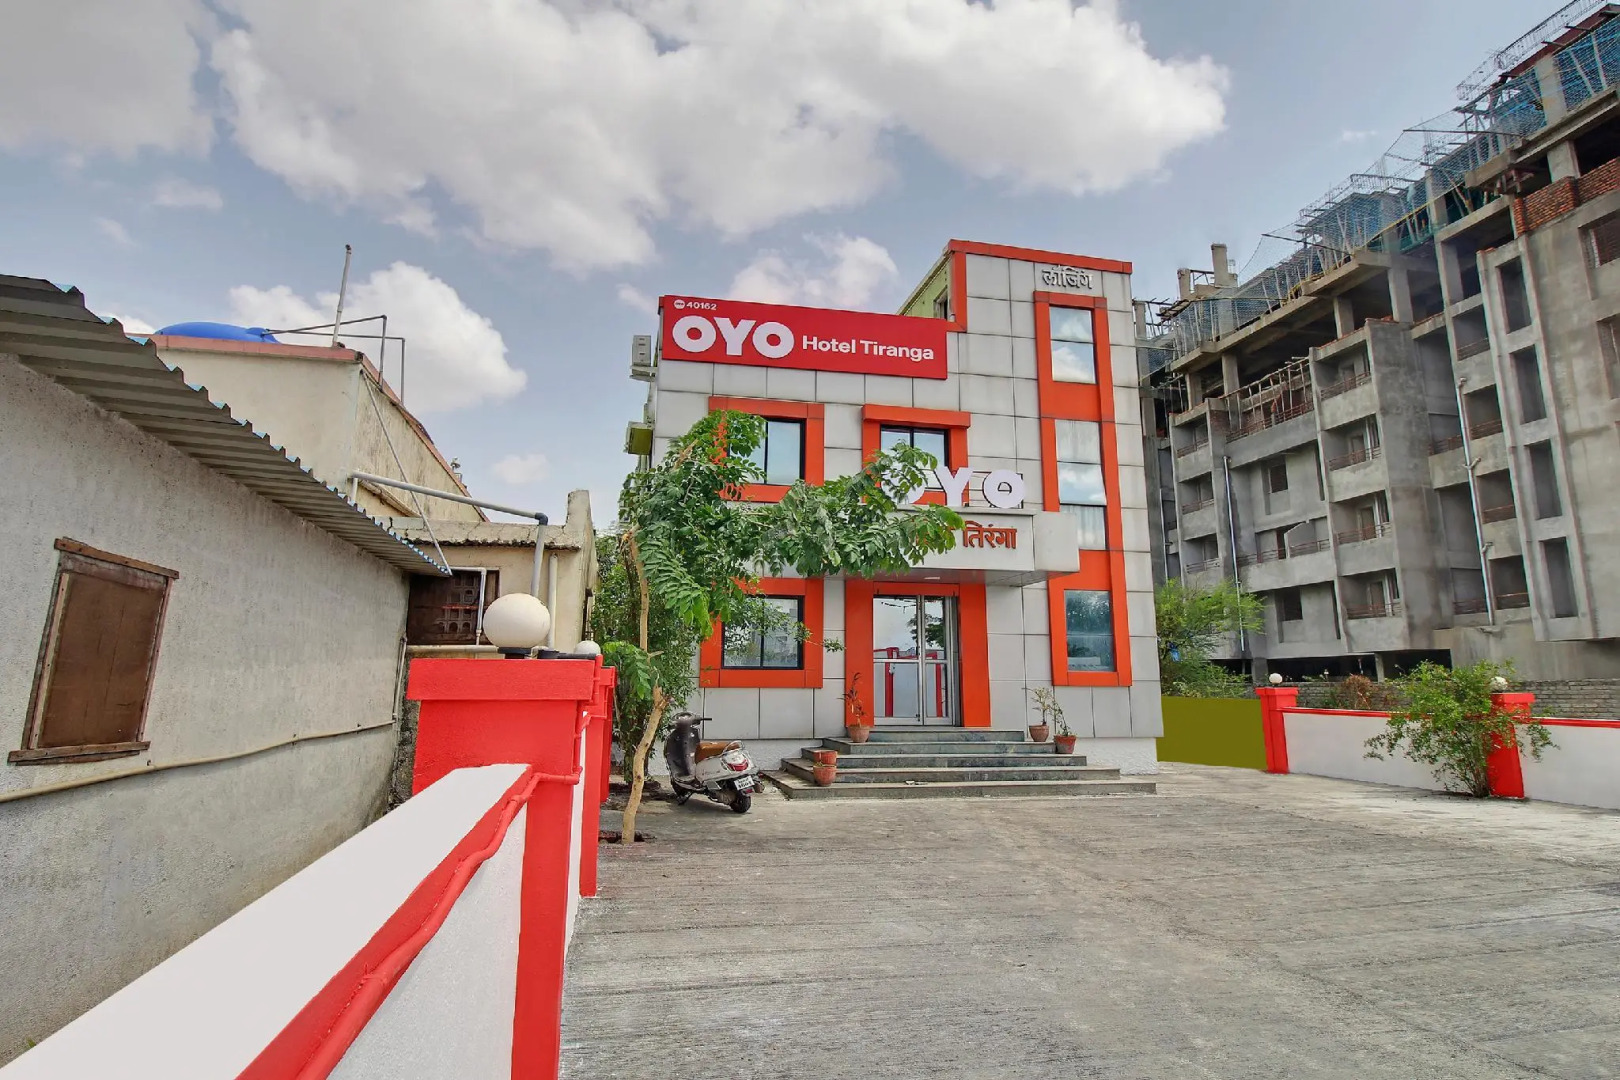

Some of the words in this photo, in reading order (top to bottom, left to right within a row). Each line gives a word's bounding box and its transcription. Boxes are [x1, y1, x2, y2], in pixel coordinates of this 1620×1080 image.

[686, 301, 717, 311] 40162
[672, 315, 794, 359] OYO
[803, 335, 856, 354] Hotel
[860, 340, 934, 362] Tiranga
[962, 520, 1018, 550] तिरंगा
